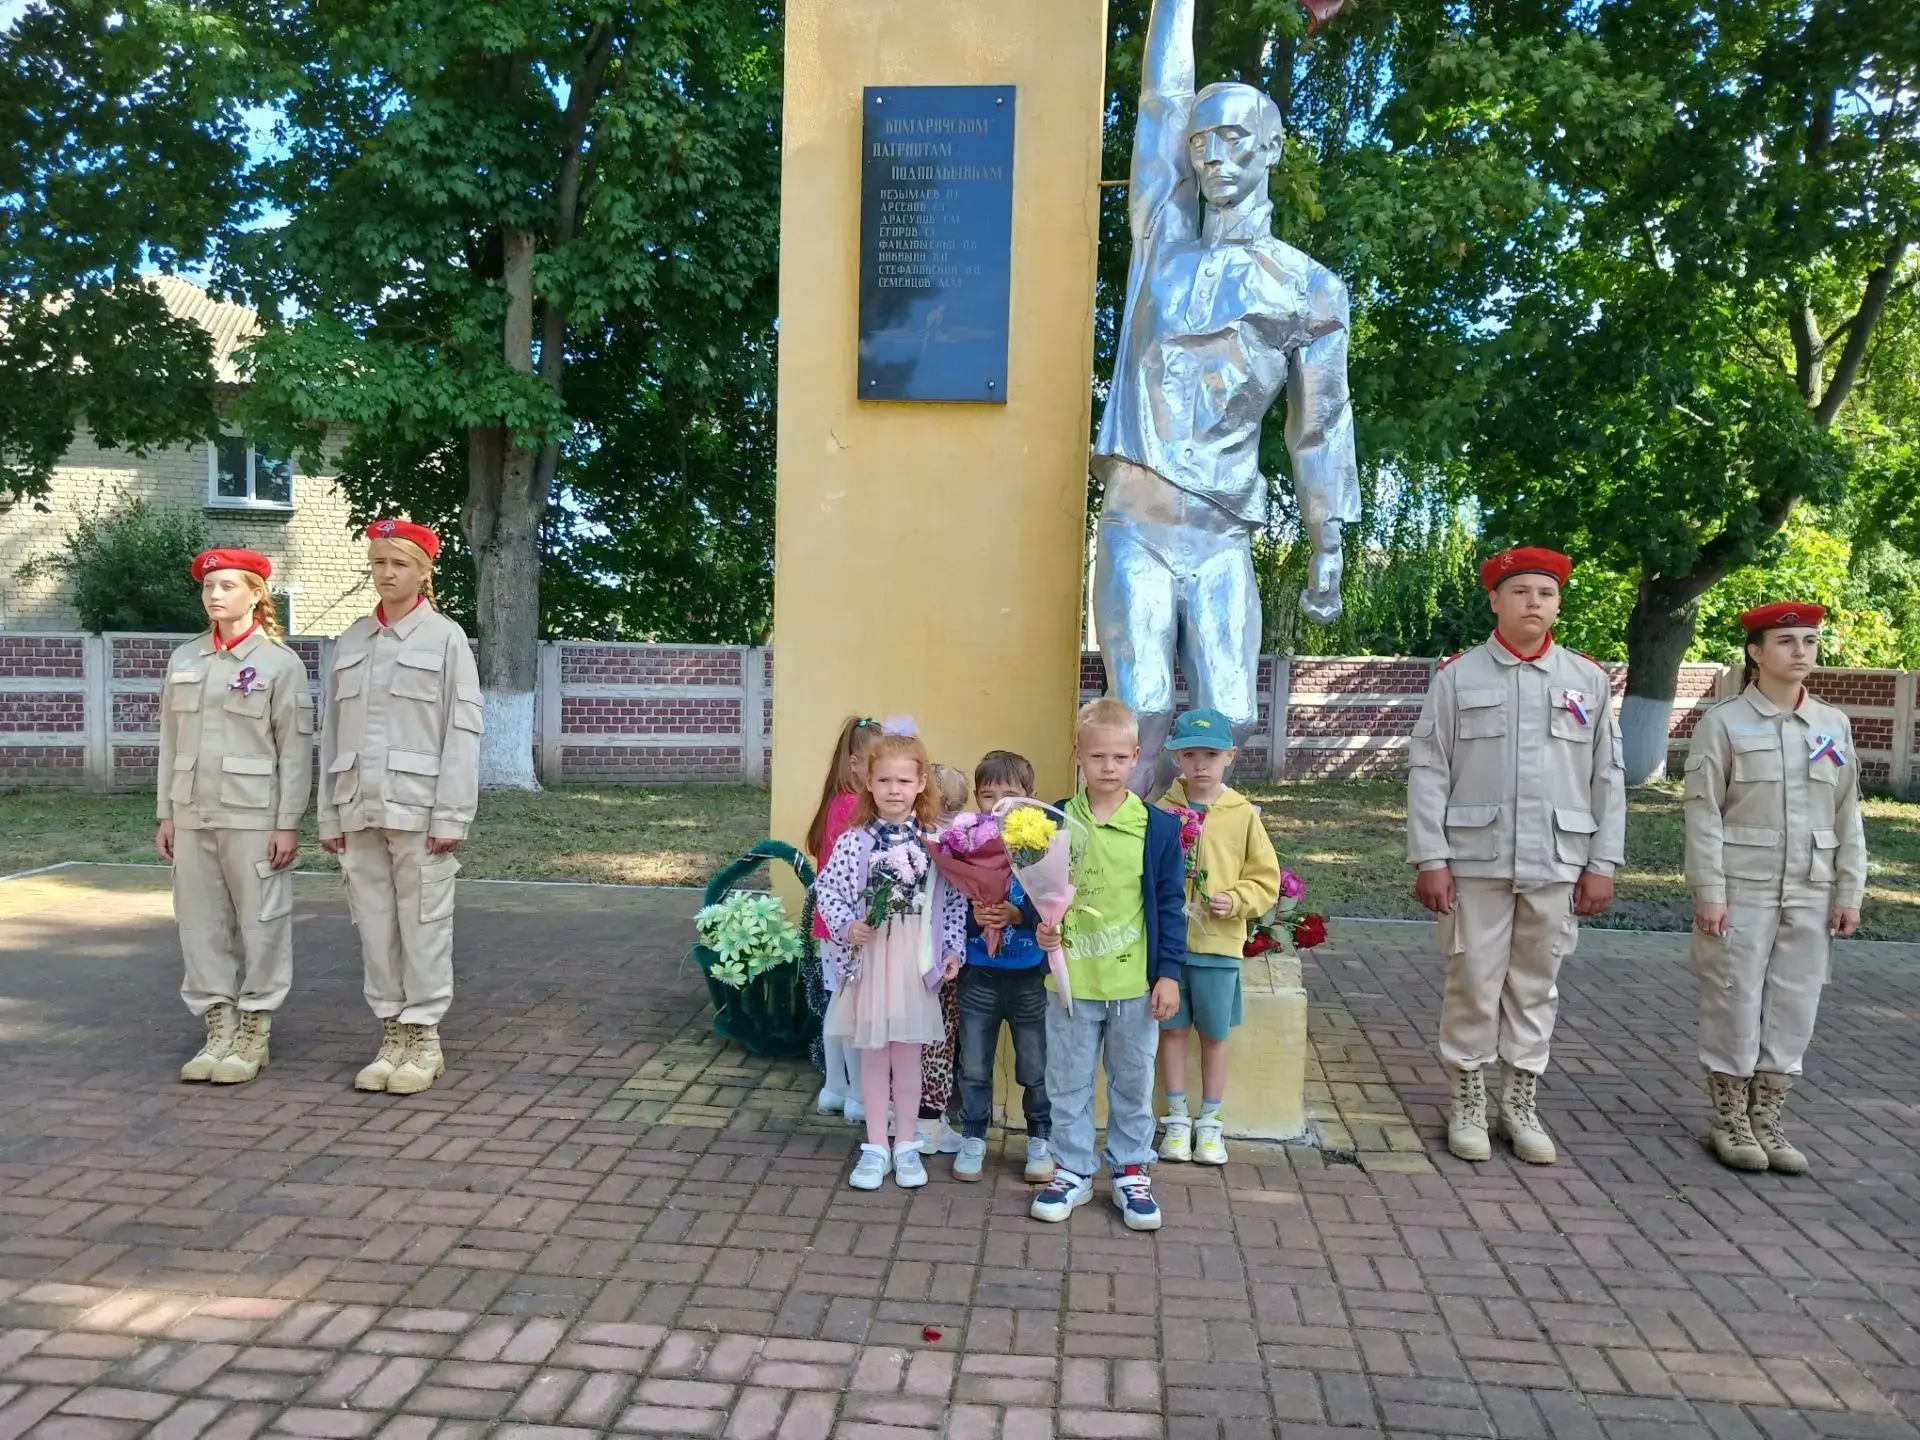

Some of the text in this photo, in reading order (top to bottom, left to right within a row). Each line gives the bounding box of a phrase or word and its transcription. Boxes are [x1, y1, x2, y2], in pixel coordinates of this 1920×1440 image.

[873, 142, 952, 157] ПАТРИОТАМ
[879, 227, 918, 238] ЕГОРОВ
[878, 277, 931, 288] СЕМЕНЦОВ
